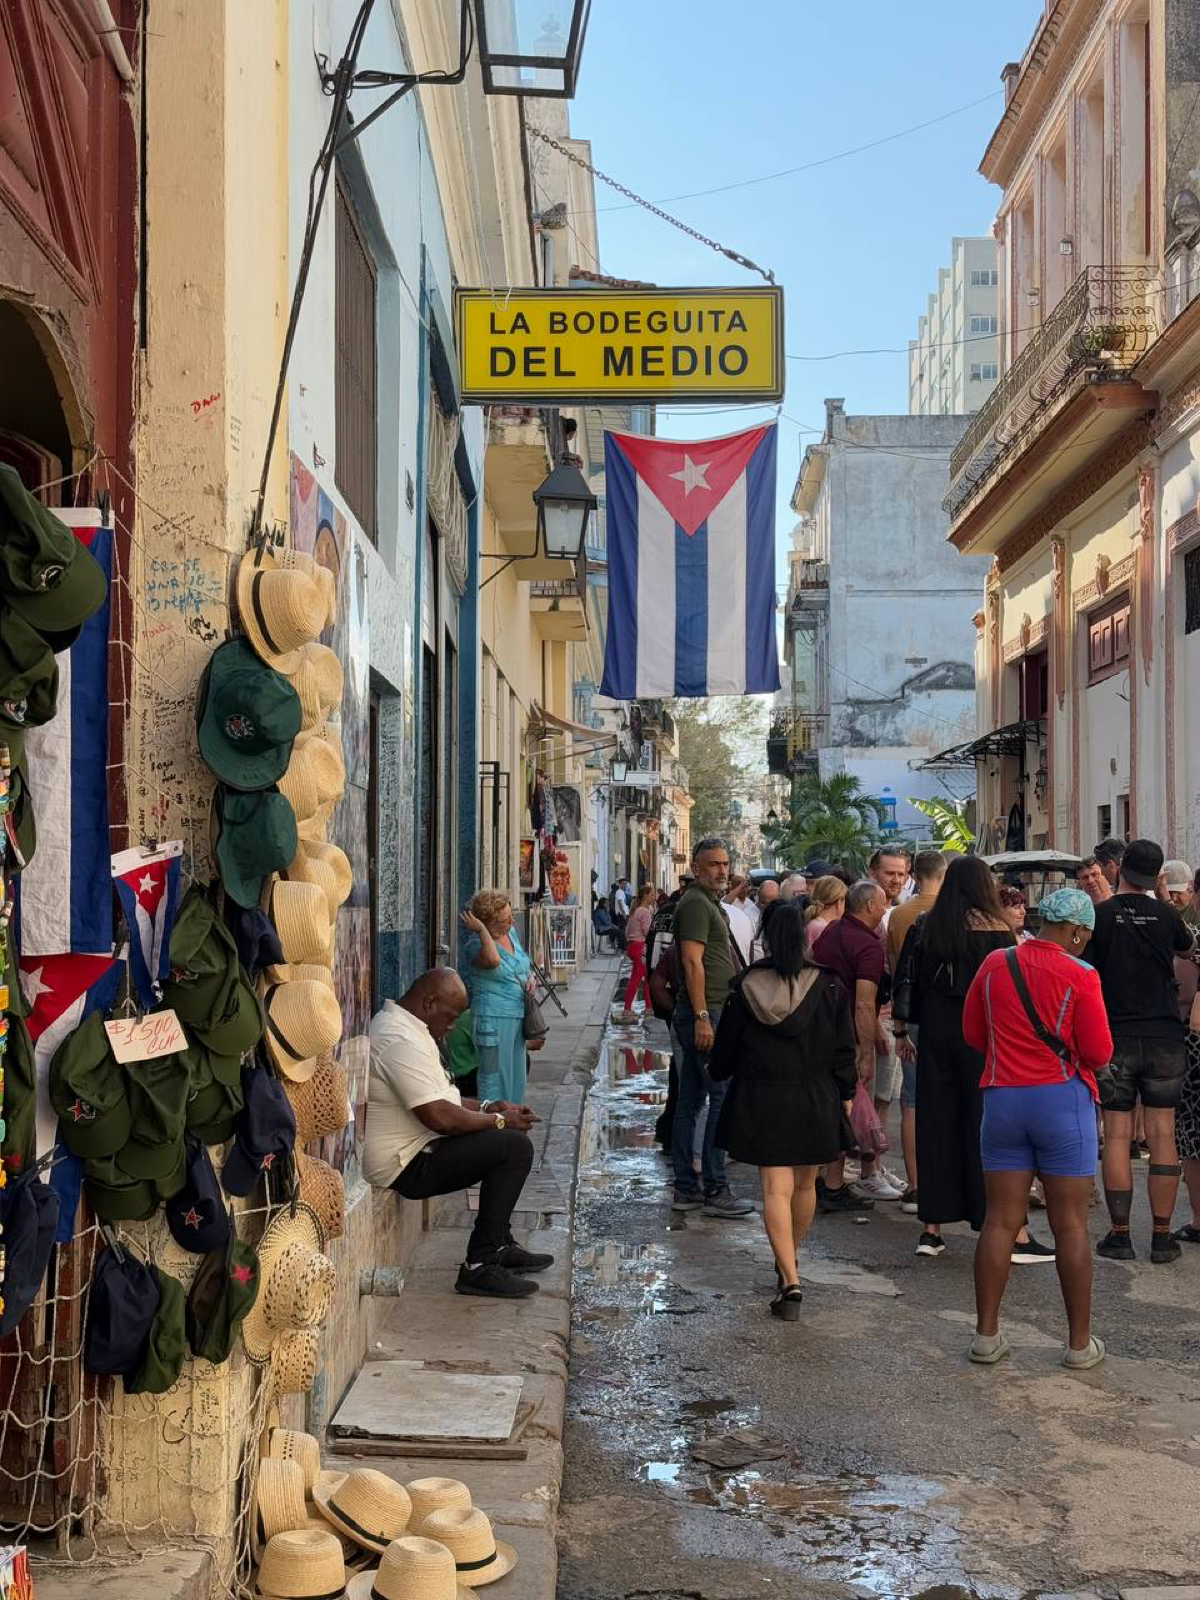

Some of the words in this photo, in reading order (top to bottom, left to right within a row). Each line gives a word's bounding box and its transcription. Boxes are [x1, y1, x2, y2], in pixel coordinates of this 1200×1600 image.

[489, 311, 531, 335] LA
[549, 310, 749, 335] BODEGUITA
[489, 346, 577, 377] DEL
[603, 344, 750, 377] MEDIO
[148, 1029, 180, 1055] CUP
